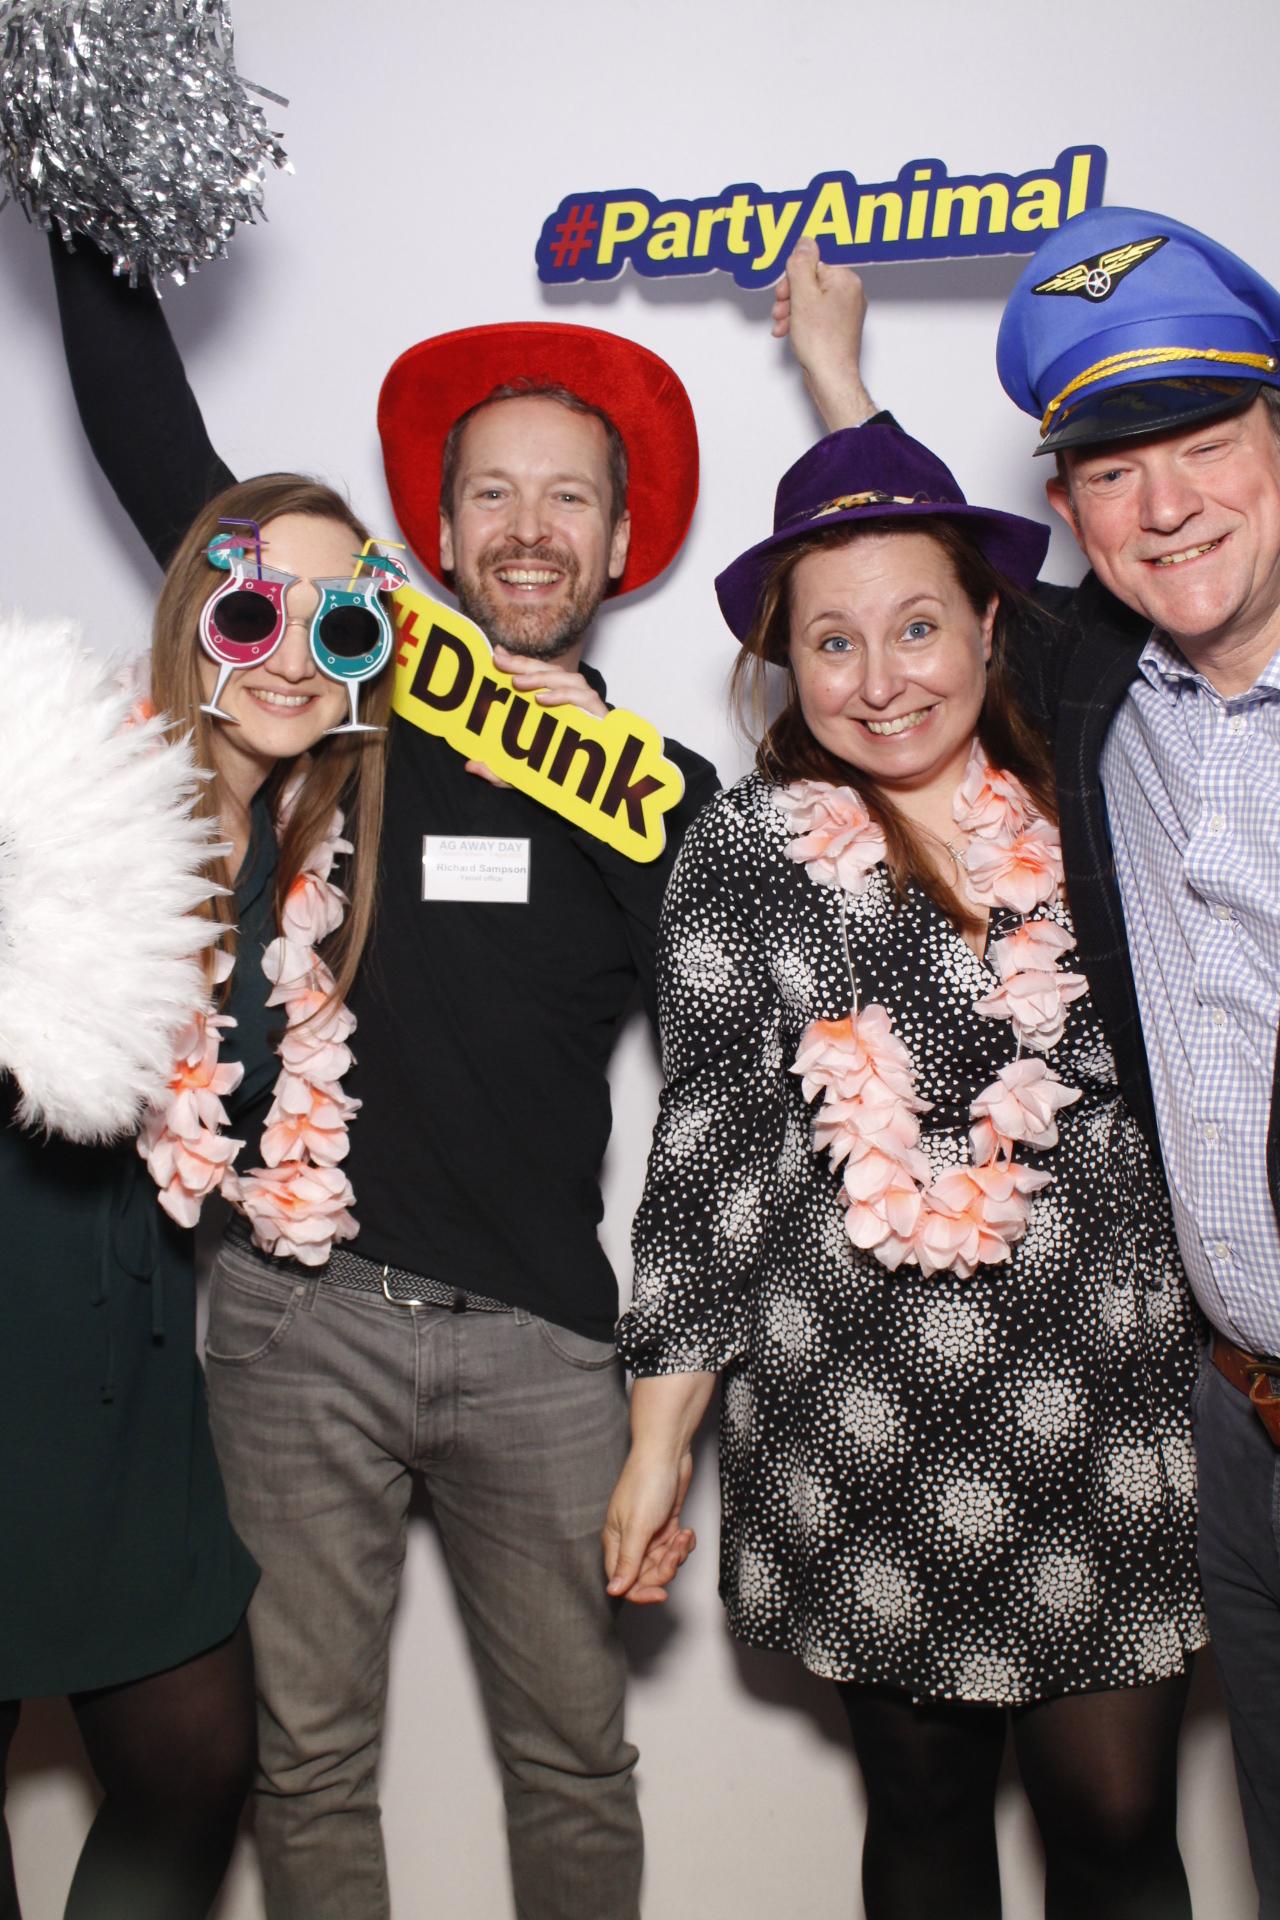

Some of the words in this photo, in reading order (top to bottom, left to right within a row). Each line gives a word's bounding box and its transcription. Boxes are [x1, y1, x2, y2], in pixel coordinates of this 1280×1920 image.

[549, 155, 1091, 270] #PartyAnimal
[440, 840, 456, 850] AG
[459, 841, 495, 851] AWAY
[498, 842, 522, 852] DAY
[436, 863, 476, 873] Richard
[479, 864, 527, 875] Sampson
